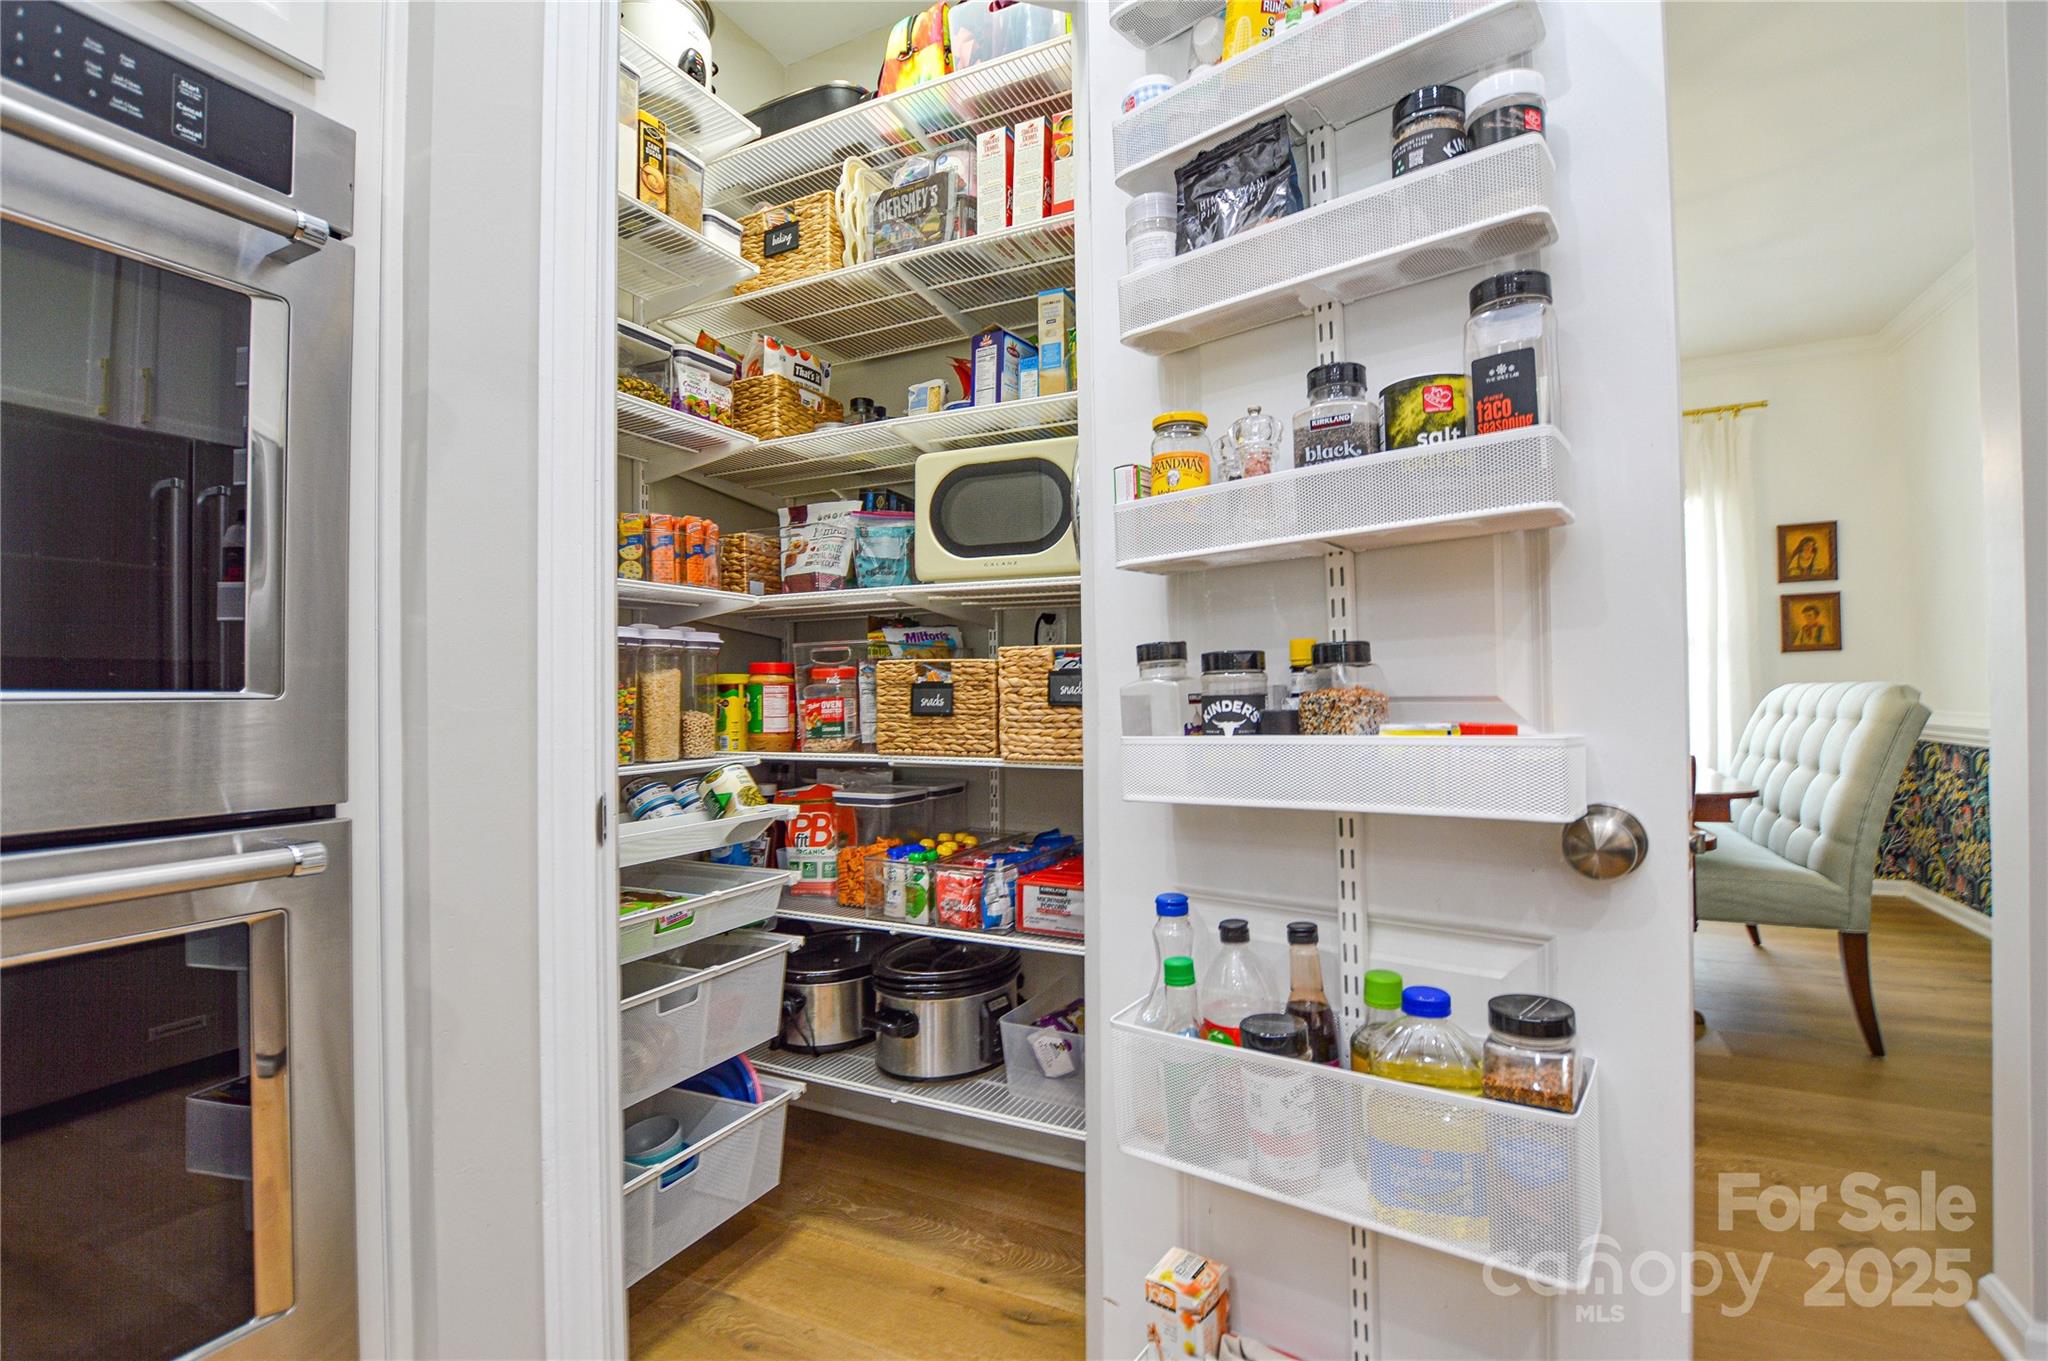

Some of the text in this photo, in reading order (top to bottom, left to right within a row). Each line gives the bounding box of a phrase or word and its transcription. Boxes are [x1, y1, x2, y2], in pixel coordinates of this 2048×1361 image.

[176, 101, 203, 119] Cancel
[175, 123, 202, 140] Cancel
[1199, 175, 1265, 212] HIMAAYAN
[878, 184, 939, 223] HERSHEY'S
[772, 232, 793, 247] baking
[795, 366, 815, 382] That's
[1477, 398, 1512, 424] taco
[1311, 414, 1350, 427] KIRKLAND
[1477, 411, 1534, 435] seasoning
[1416, 426, 1461, 448] salt
[904, 631, 950, 644] Milton's
[1059, 681, 1082, 696] snac
[821, 700, 843, 710] OVEN
[920, 693, 945, 707] snacks
[1203, 699, 1261, 724] KINDER'S
[787, 811, 834, 848] PB
[795, 833, 809, 848] fit
